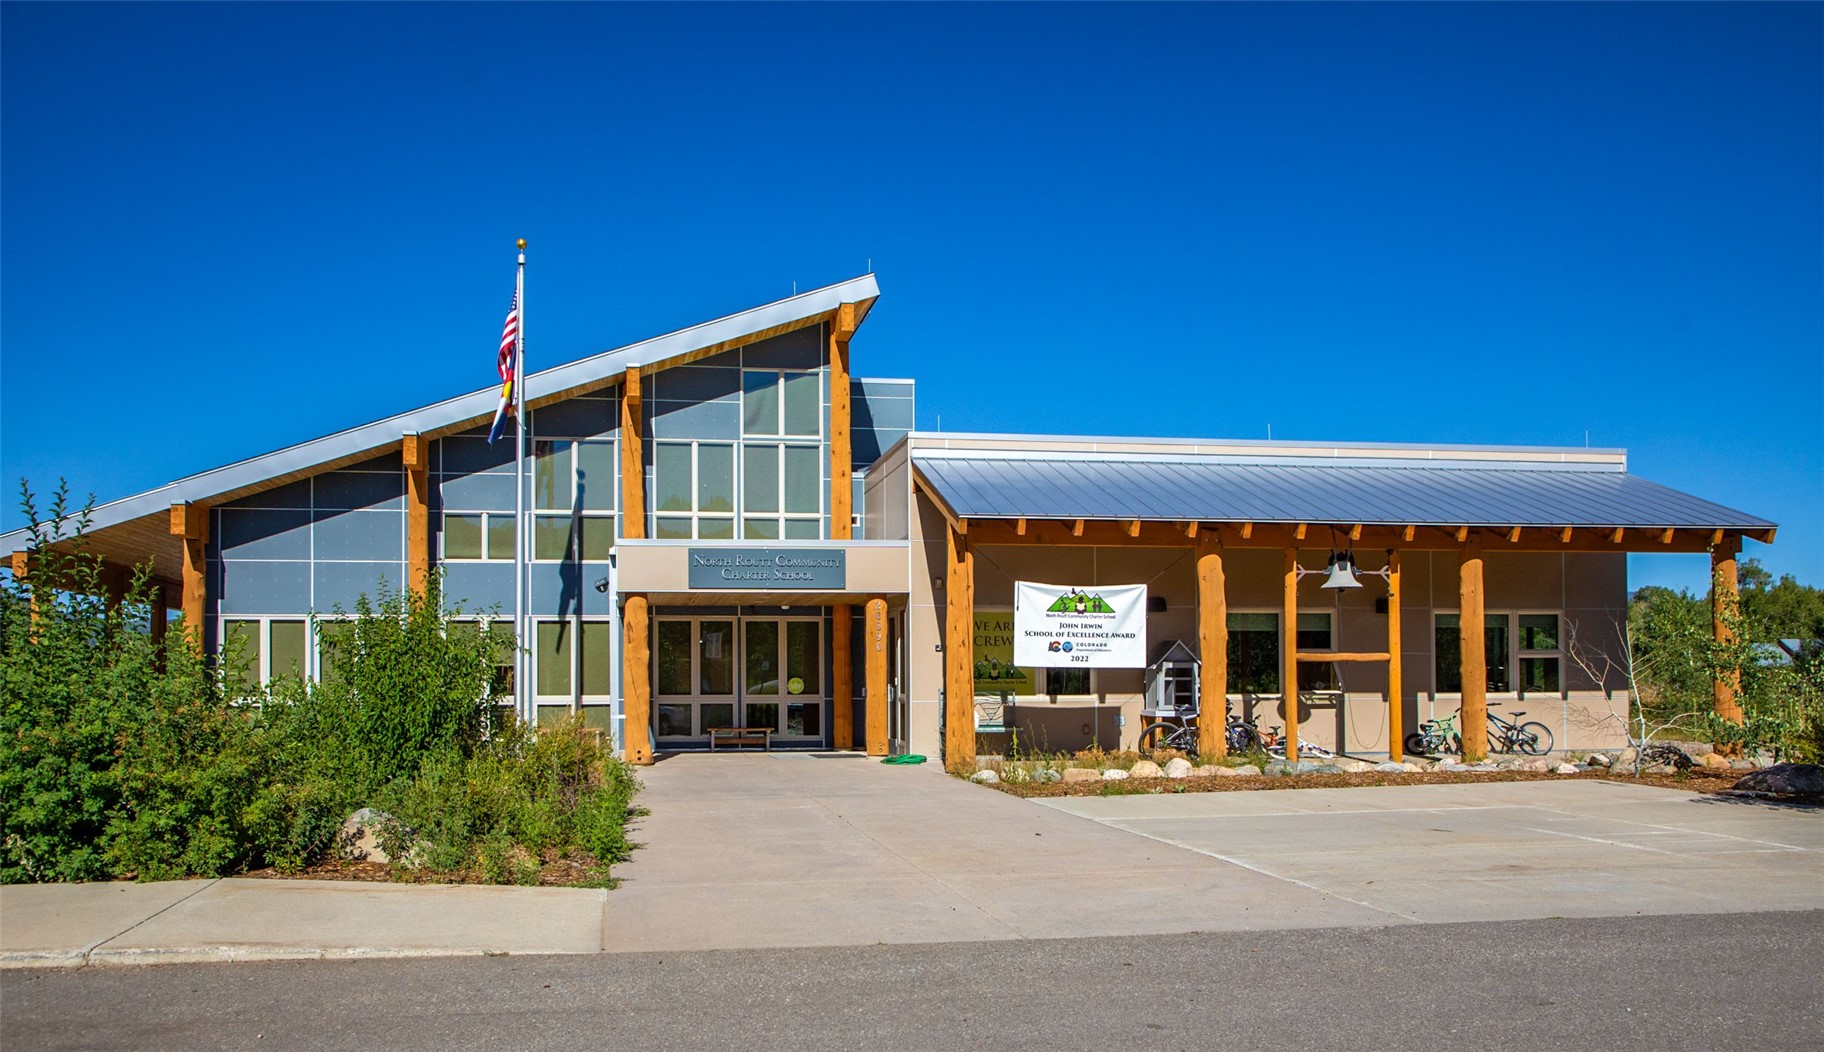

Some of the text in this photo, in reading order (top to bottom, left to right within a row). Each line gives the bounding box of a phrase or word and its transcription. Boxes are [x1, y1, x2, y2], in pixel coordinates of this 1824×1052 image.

[694, 554, 841, 568] NORTH ROUTT COMMUNITY
[721, 568, 814, 580] CHARTER SCHOOL
[974, 635, 1014, 646] CREW
